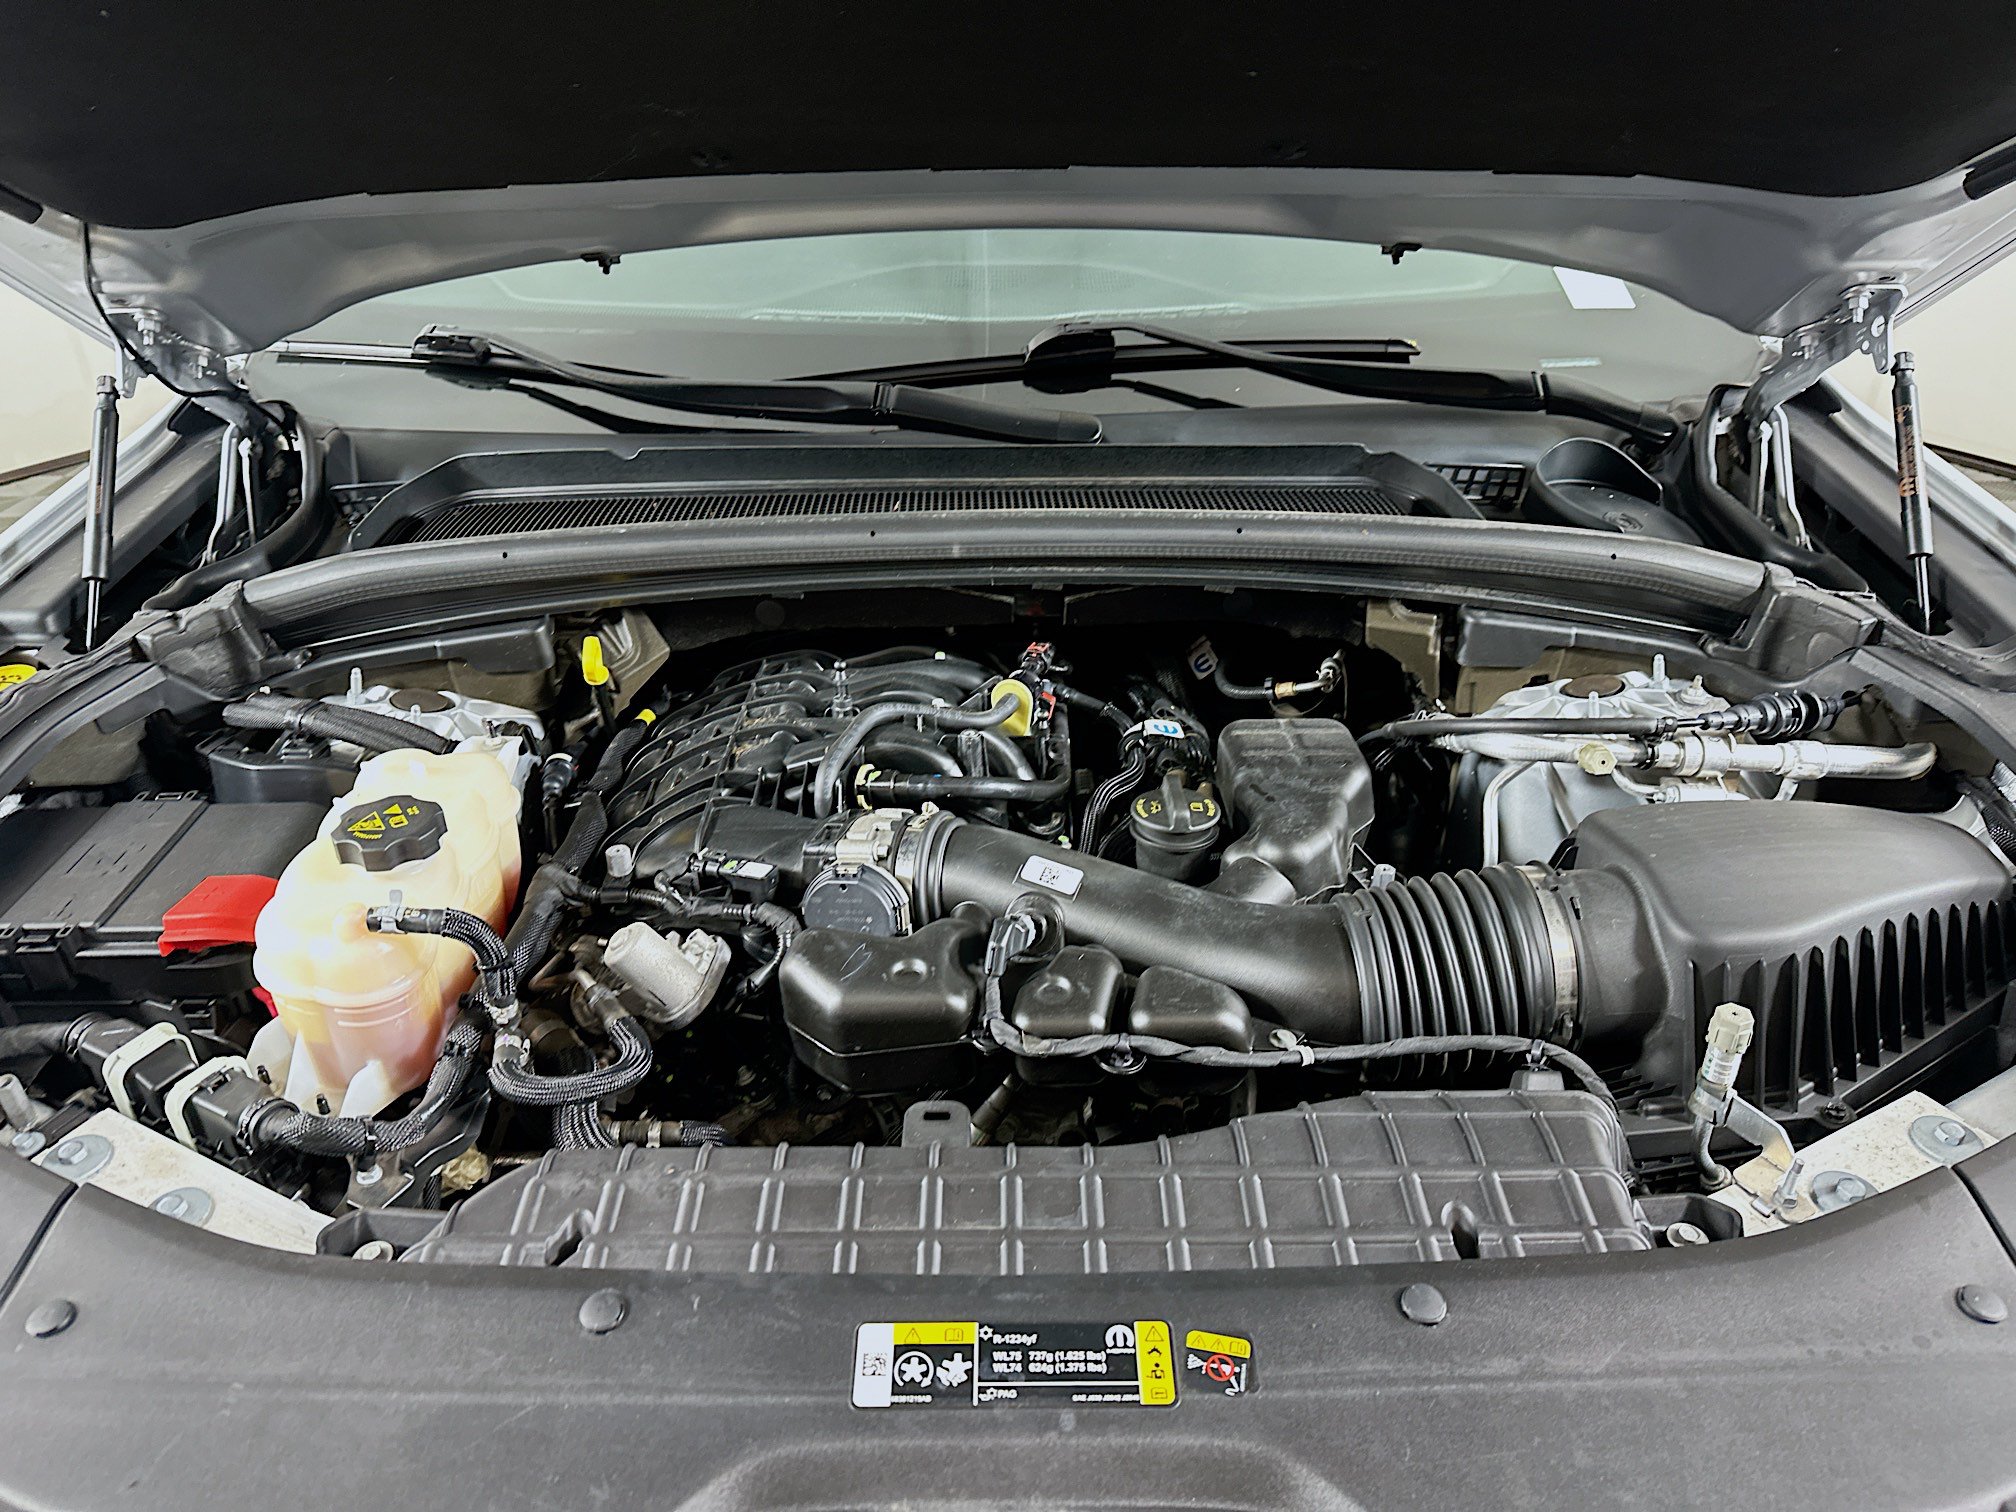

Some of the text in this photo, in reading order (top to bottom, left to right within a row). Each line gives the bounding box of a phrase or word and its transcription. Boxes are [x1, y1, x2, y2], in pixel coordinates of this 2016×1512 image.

[992, 1351, 1022, 1361] WL75
[1028, 1351, 1053, 1362] 737g
[992, 1362, 1022, 1373] WL74
